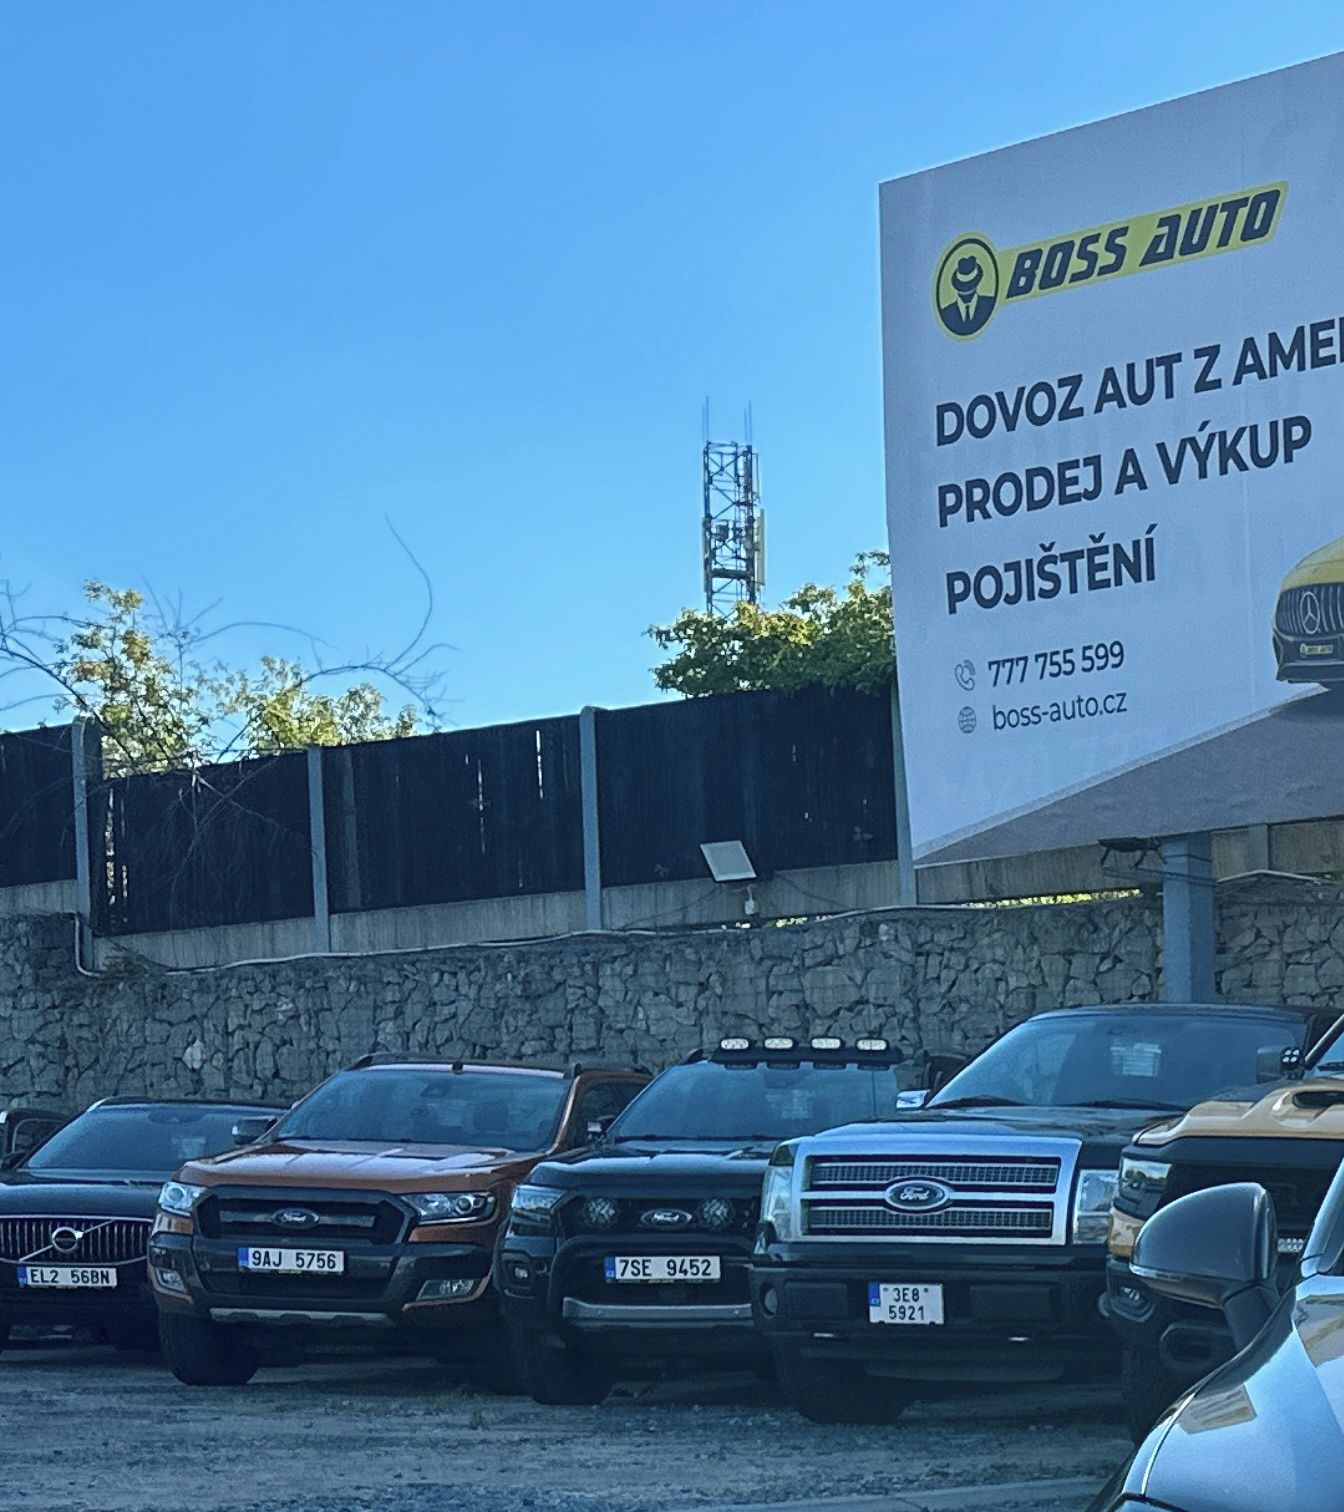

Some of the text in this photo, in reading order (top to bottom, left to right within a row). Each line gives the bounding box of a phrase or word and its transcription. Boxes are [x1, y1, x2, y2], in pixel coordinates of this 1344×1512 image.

[1006, 189, 1281, 298] BOSS AUTO
[935, 374, 1084, 446] DOVOZ
[1094, 352, 1182, 414] AUT
[1193, 346, 1223, 393] Z
[938, 415, 1313, 528] PRODEJ A VÝKUP
[946, 523, 1158, 615] POJIŠTĚNÍ
[988, 640, 1125, 687] 777 755 599
[993, 691, 1128, 731] boss-auto.cz
[900, 1186, 930, 1201] Ford
[252, 1250, 337, 1270] 9AJ 5756
[619, 1258, 712, 1277] 7SE 9452
[30, 1269, 110, 1285] EL2 56BN
[893, 1287, 920, 1302] 3E8
[888, 1305, 925, 1321] 5921
